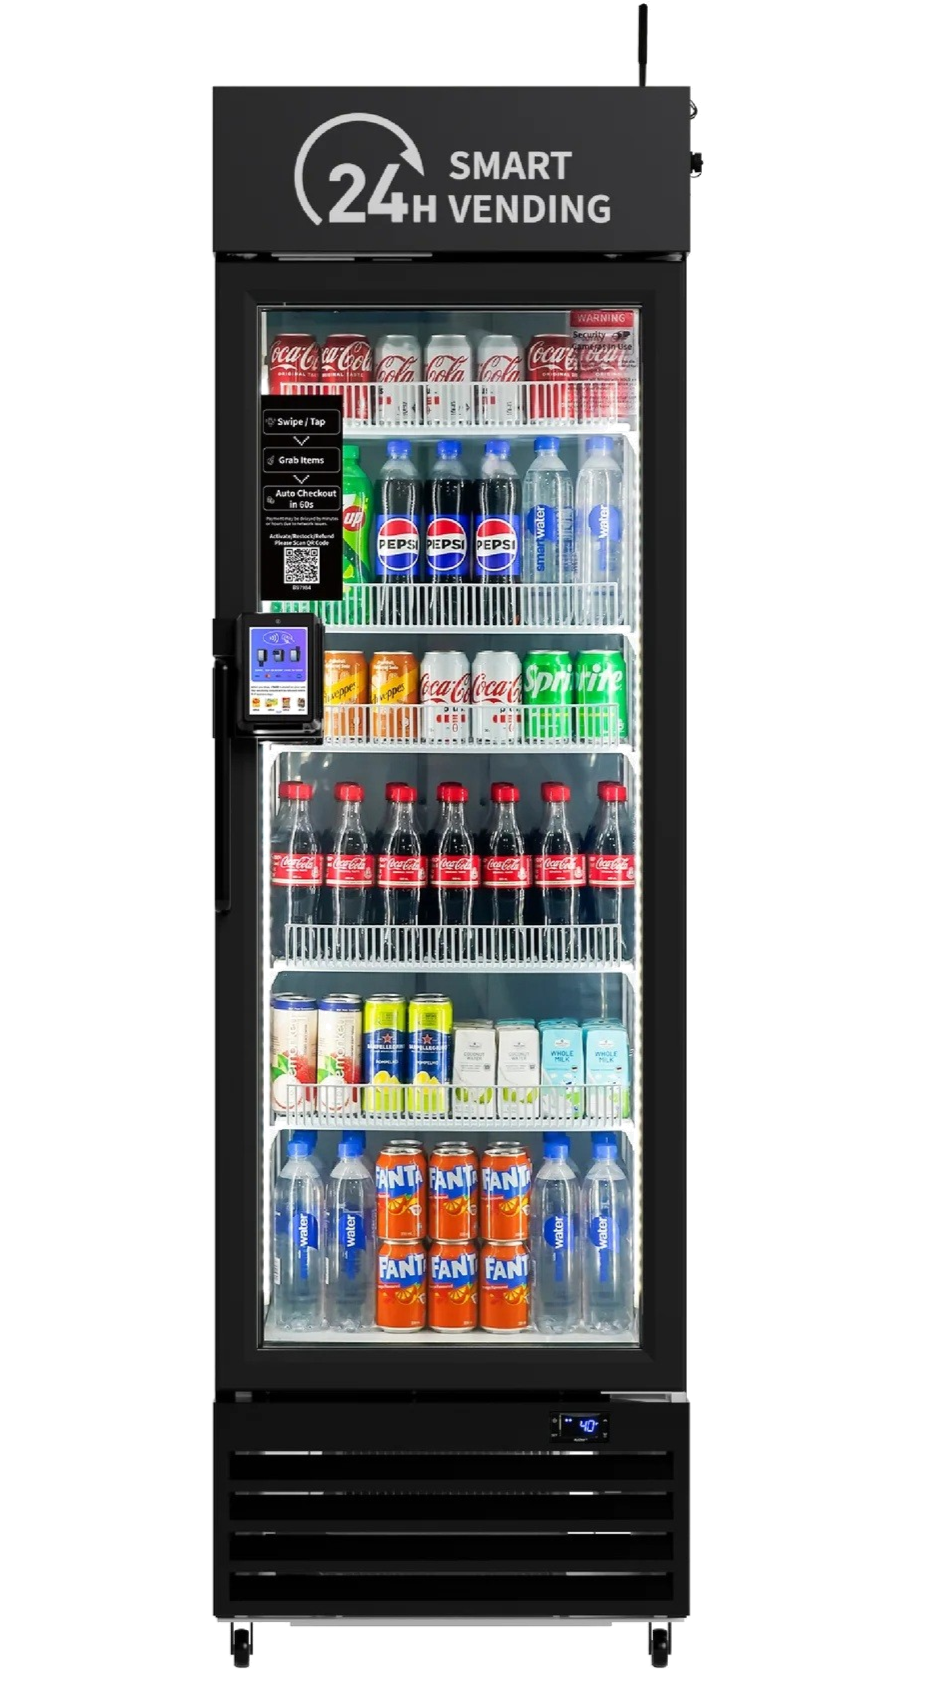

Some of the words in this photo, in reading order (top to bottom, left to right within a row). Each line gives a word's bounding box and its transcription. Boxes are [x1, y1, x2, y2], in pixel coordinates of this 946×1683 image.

[449, 151, 572, 180] SMART
[448, 194, 611, 223] VENDING
[577, 313, 626, 323] WARNING
[573, 330, 606, 341] Security
[277, 417, 303, 427] Swipe
[304, 417, 309, 427] /
[310, 417, 326, 427] Tap
[278, 456, 299, 464] Grab
[300, 456, 325, 464] Items
[275, 489, 295, 497] Auto
[297, 489, 337, 497] Checkout
[289, 500, 298, 508] in
[299, 501, 314, 509] 60s
[379, 539, 419, 551] PEPSI
[427, 539, 465, 551] PEPSI
[477, 539, 516, 551] PEPSI
[376, 1165, 423, 1189] FANTA
[299, 1213, 309, 1247] water
[345, 1214, 356, 1248] water
[553, 1216, 564, 1249] water
[598, 1216, 608, 1250] water
[379, 1253, 426, 1280] FANT
[431, 1253, 478, 1280] FANT
